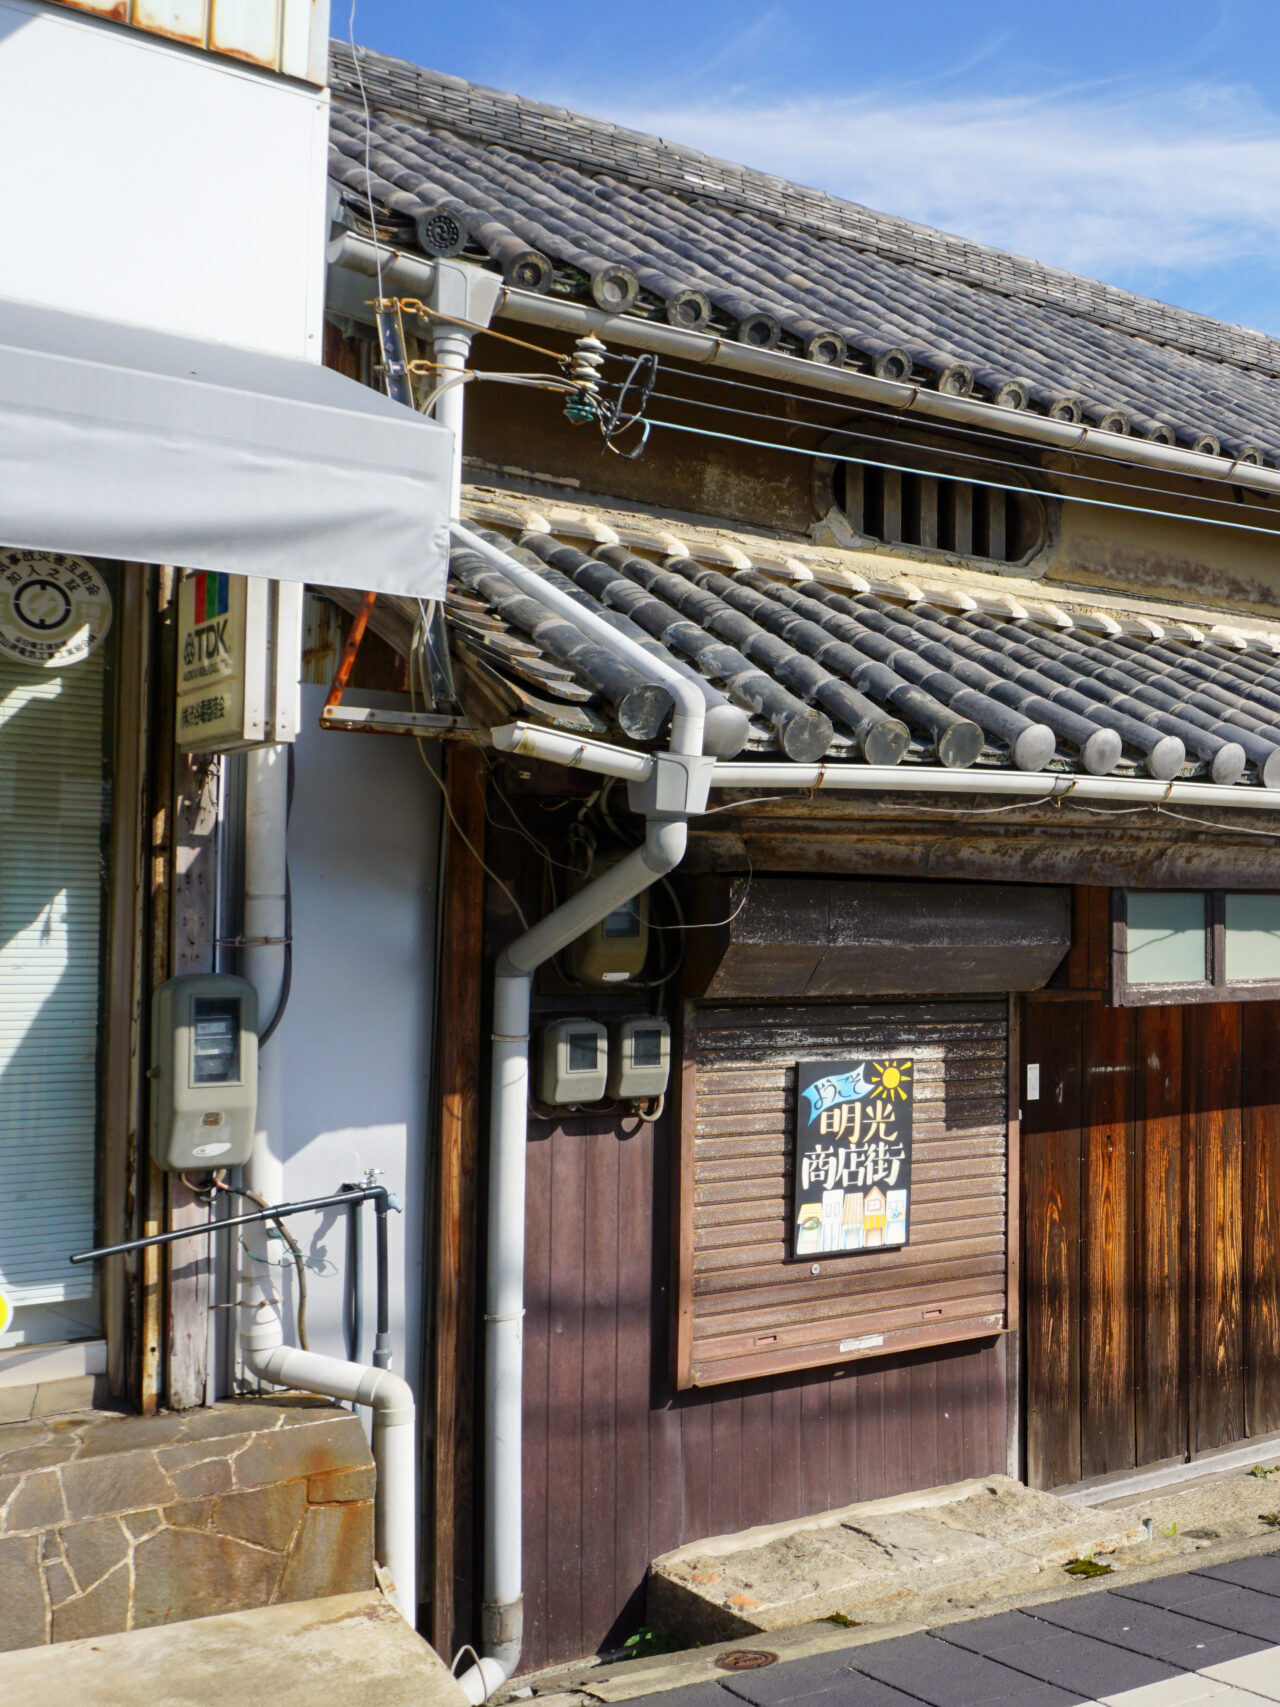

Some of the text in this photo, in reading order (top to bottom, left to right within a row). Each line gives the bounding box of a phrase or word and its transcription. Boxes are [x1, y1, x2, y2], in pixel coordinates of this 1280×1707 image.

[194, 619, 229, 662] TDK
[813, 1073, 863, 1110] ようこそ
[820, 1100, 898, 1144] 明光
[802, 1142, 906, 1190] 商店街
